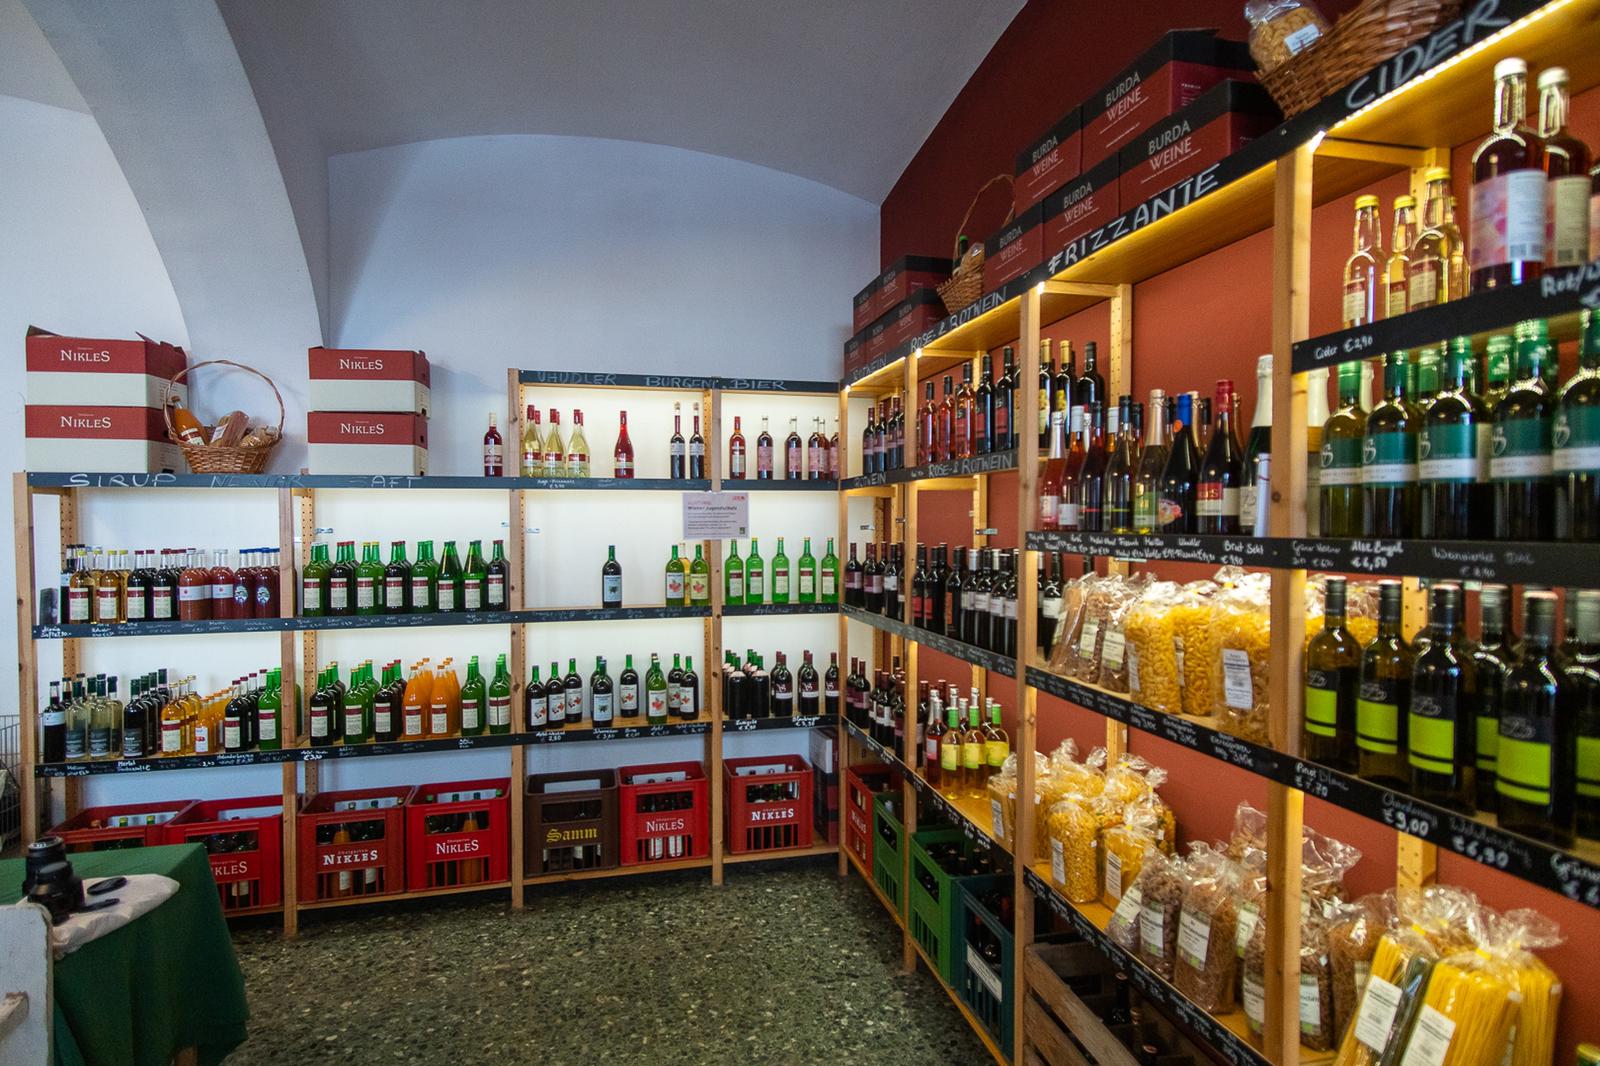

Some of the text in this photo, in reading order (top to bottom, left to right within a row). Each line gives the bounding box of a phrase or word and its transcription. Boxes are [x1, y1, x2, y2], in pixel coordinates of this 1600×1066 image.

[1345, 0, 1511, 109] CIDER
[1106, 72, 1140, 107] BURDA
[1107, 87, 1141, 122] WEINE
[1148, 120, 1191, 155] BURDA
[1032, 136, 1058, 163] BURDA
[1150, 136, 1192, 171] WEINE
[1032, 149, 1059, 176] WEINE
[1063, 181, 1093, 209] BURDA
[1048, 163, 1220, 275] FRIZZANTE
[1064, 197, 1093, 223] WEINE
[1000, 226, 1023, 248] BURDA
[1000, 239, 1023, 262] WEINE
[60, 349, 111, 362] NIKLES
[339, 358, 383, 370] NIKLES
[729, 379, 787, 391] BIER
[60, 416, 112, 428] NIKLES
[340, 423, 384, 434] NIKLES
[961, 453, 1013, 474] ROTWEIN
[62, 473, 176, 488] SIRUP
[1223, 540, 1264, 555] Brut Sekt
[1296, 762, 1317, 778] Pinot
[751, 808, 794, 822] NIKLES
[546, 826, 598, 844] Samm
[646, 818, 685, 833] NIKLES
[436, 839, 480, 855] NIKLES
[323, 849, 379, 866] NIKLES
